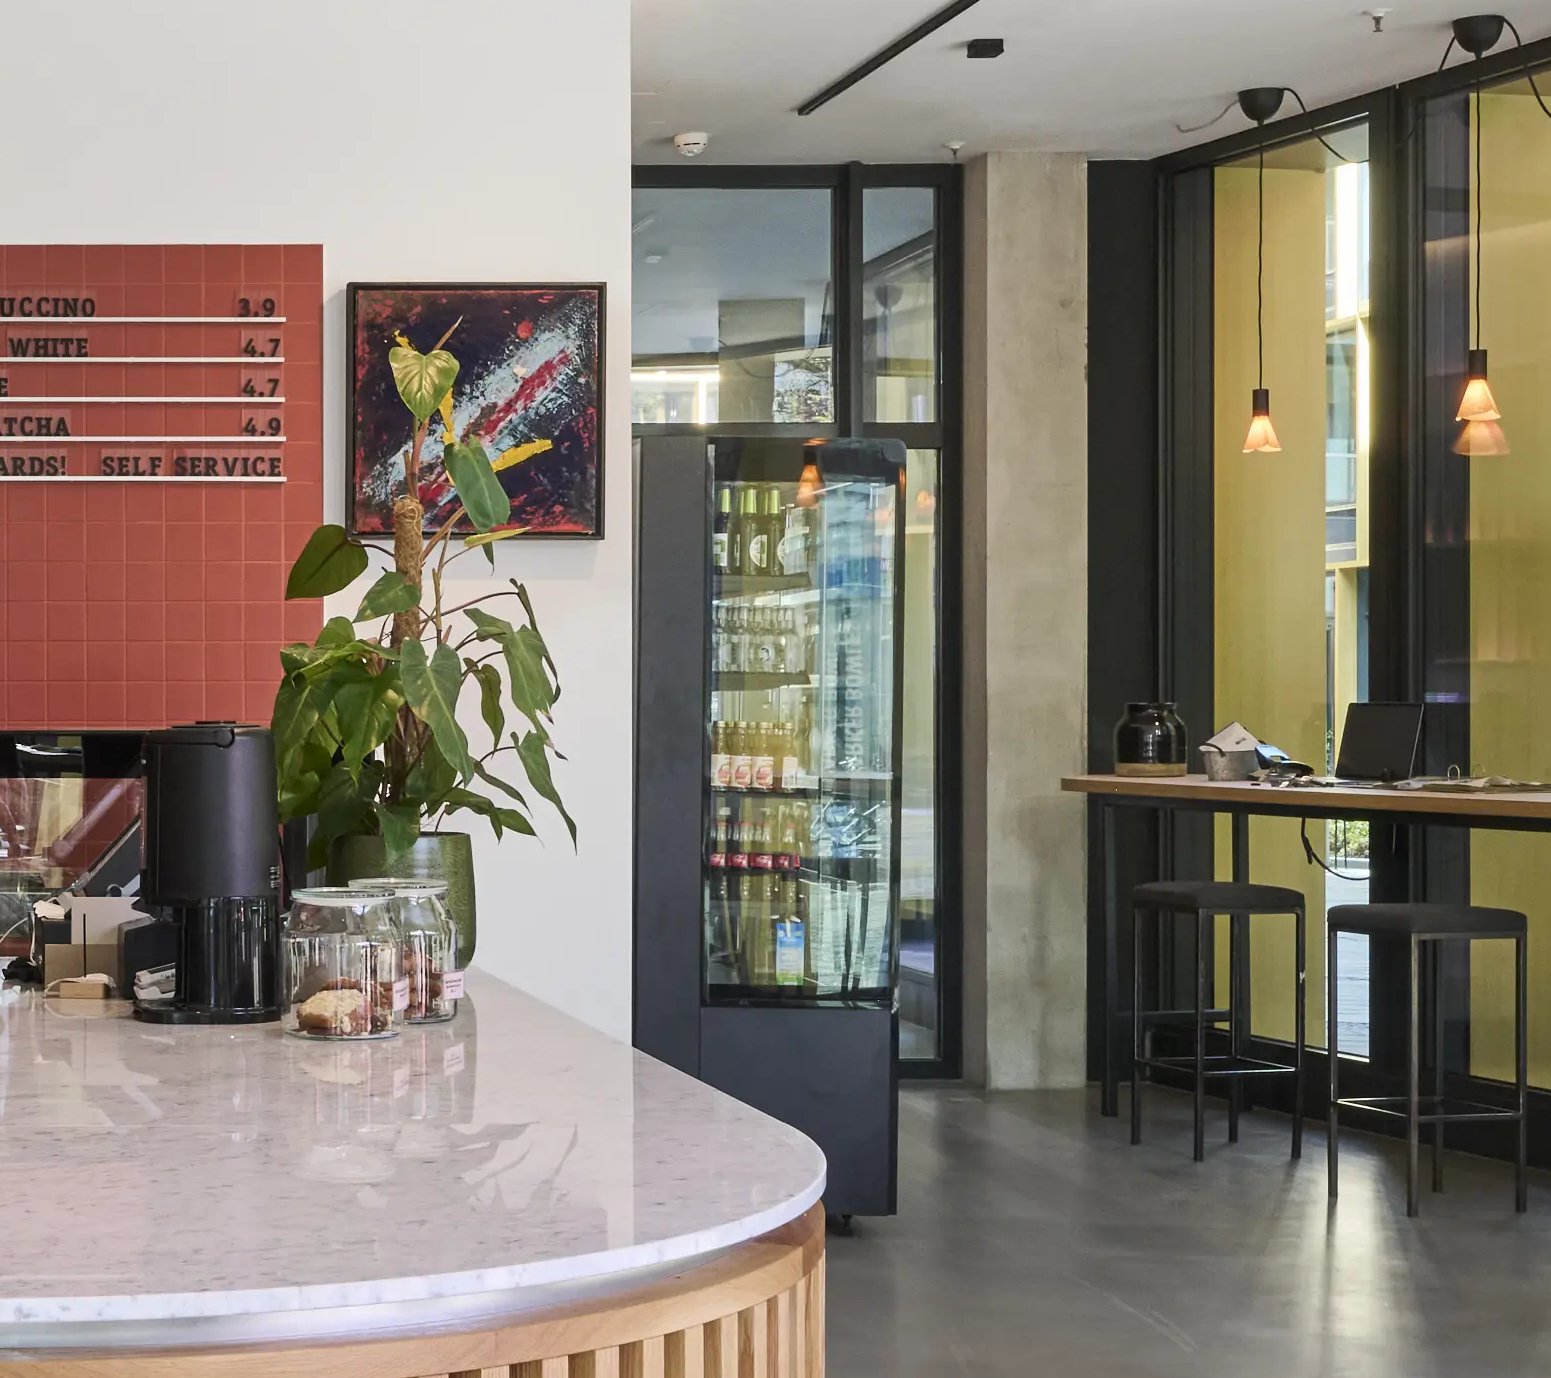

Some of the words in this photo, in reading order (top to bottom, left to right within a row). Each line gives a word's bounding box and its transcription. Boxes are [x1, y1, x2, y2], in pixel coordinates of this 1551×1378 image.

[238, 298, 276, 317] 3.9
[9, 337, 89, 357] WHITE
[243, 338, 281, 357] 4.7
[242, 378, 280, 397] 4.7
[243, 417, 282, 437] 4.9
[102, 456, 162, 477] SELF
[174, 456, 282, 477] SERVICE
